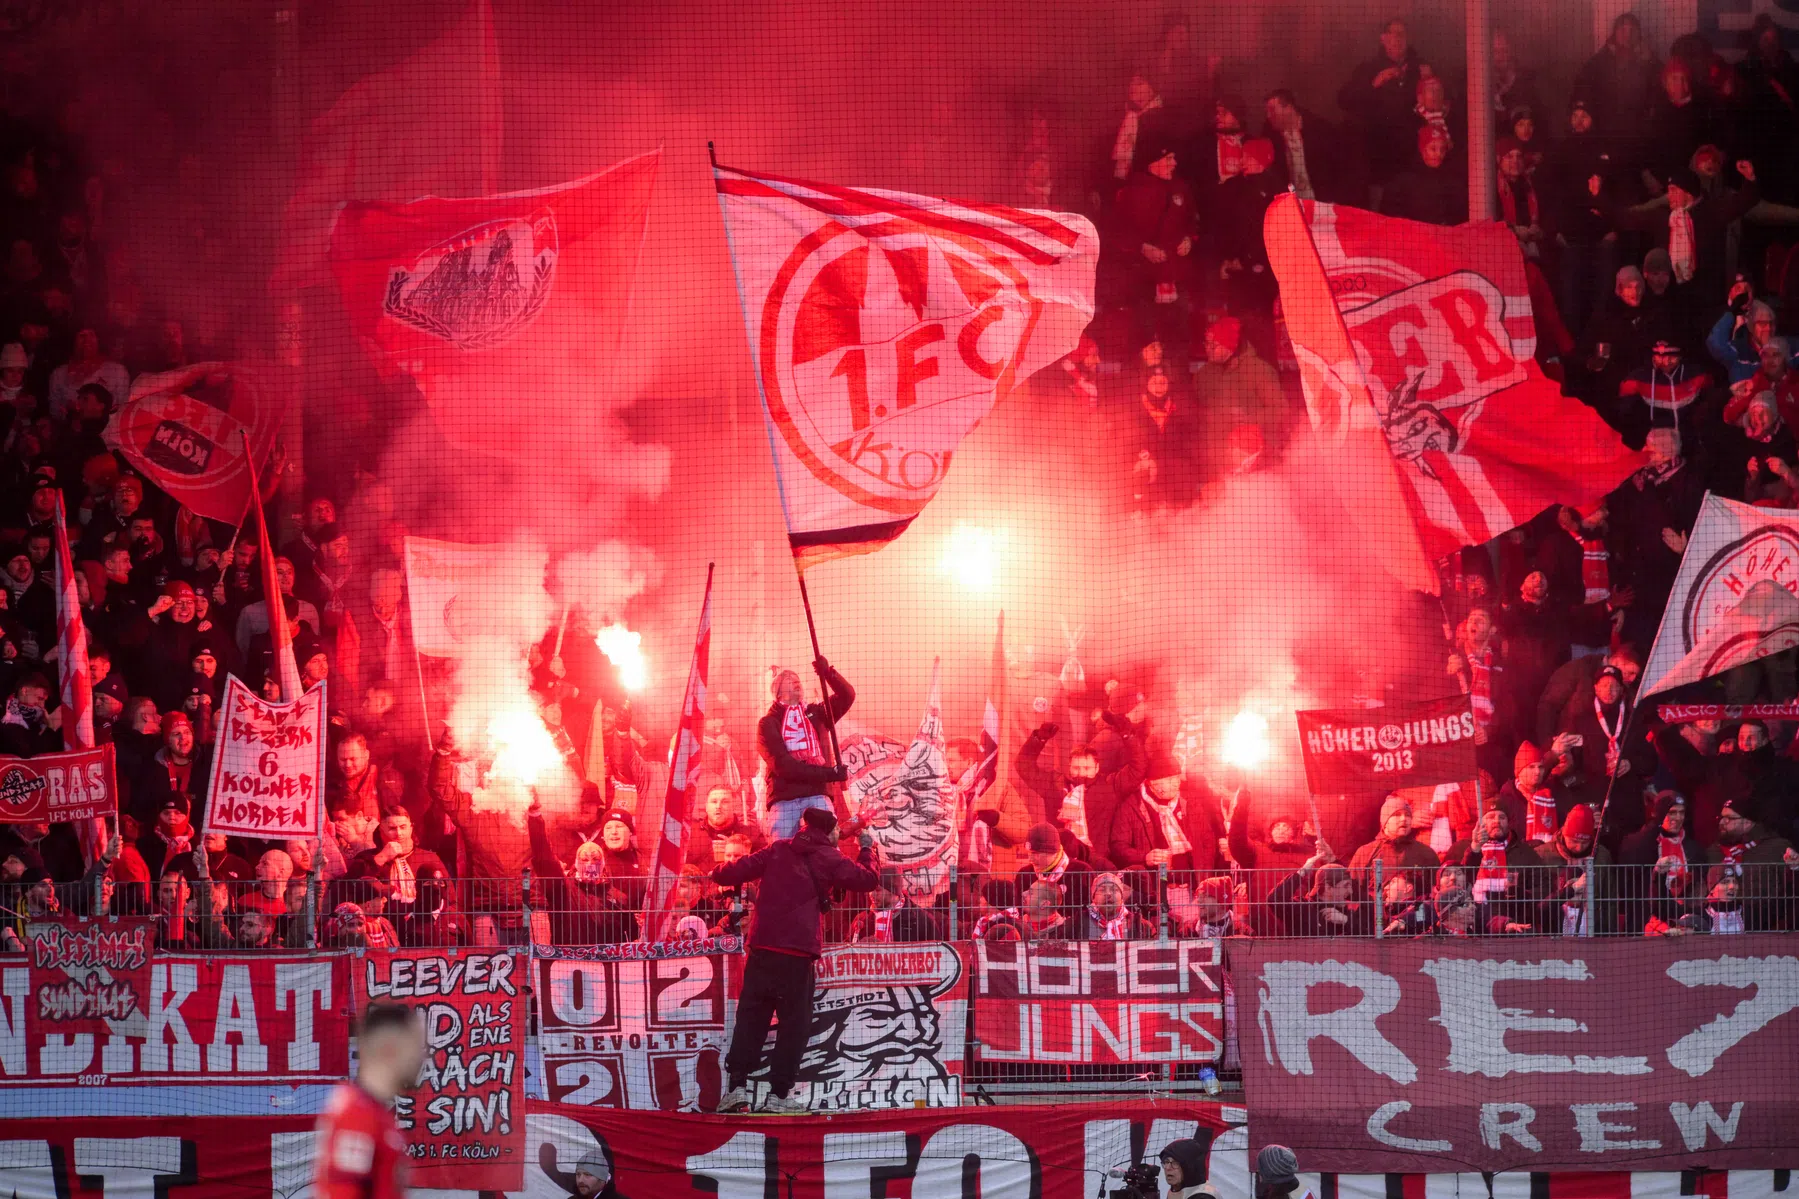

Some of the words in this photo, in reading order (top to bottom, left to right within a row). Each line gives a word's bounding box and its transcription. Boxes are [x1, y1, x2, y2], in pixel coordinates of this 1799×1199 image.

[1307, 724, 1378, 754] HÖHER
[1403, 711, 1474, 748] JUNGS
[258, 751, 278, 777] 6
[1372, 750, 1413, 772] 2013
[47, 762, 106, 807] RAS
[222, 771, 313, 800] KÖLNER
[69, 807, 94, 820] KÖLN
[218, 797, 307, 828] NORDEN
[663, 938, 715, 956] ESSEN
[366, 954, 517, 998] LEEVER
[468, 1001, 512, 1026] ALS
[469, 1024, 512, 1049] ENE
[980, 1002, 1223, 1062] JUNGS
[78, 1074, 108, 1086] 2007
[427, 1089, 511, 1136] SIN!
[1367, 1100, 1745, 1154] CREW
[441, 1143, 458, 1159] FC
[462, 1141, 500, 1160] KÖLN
